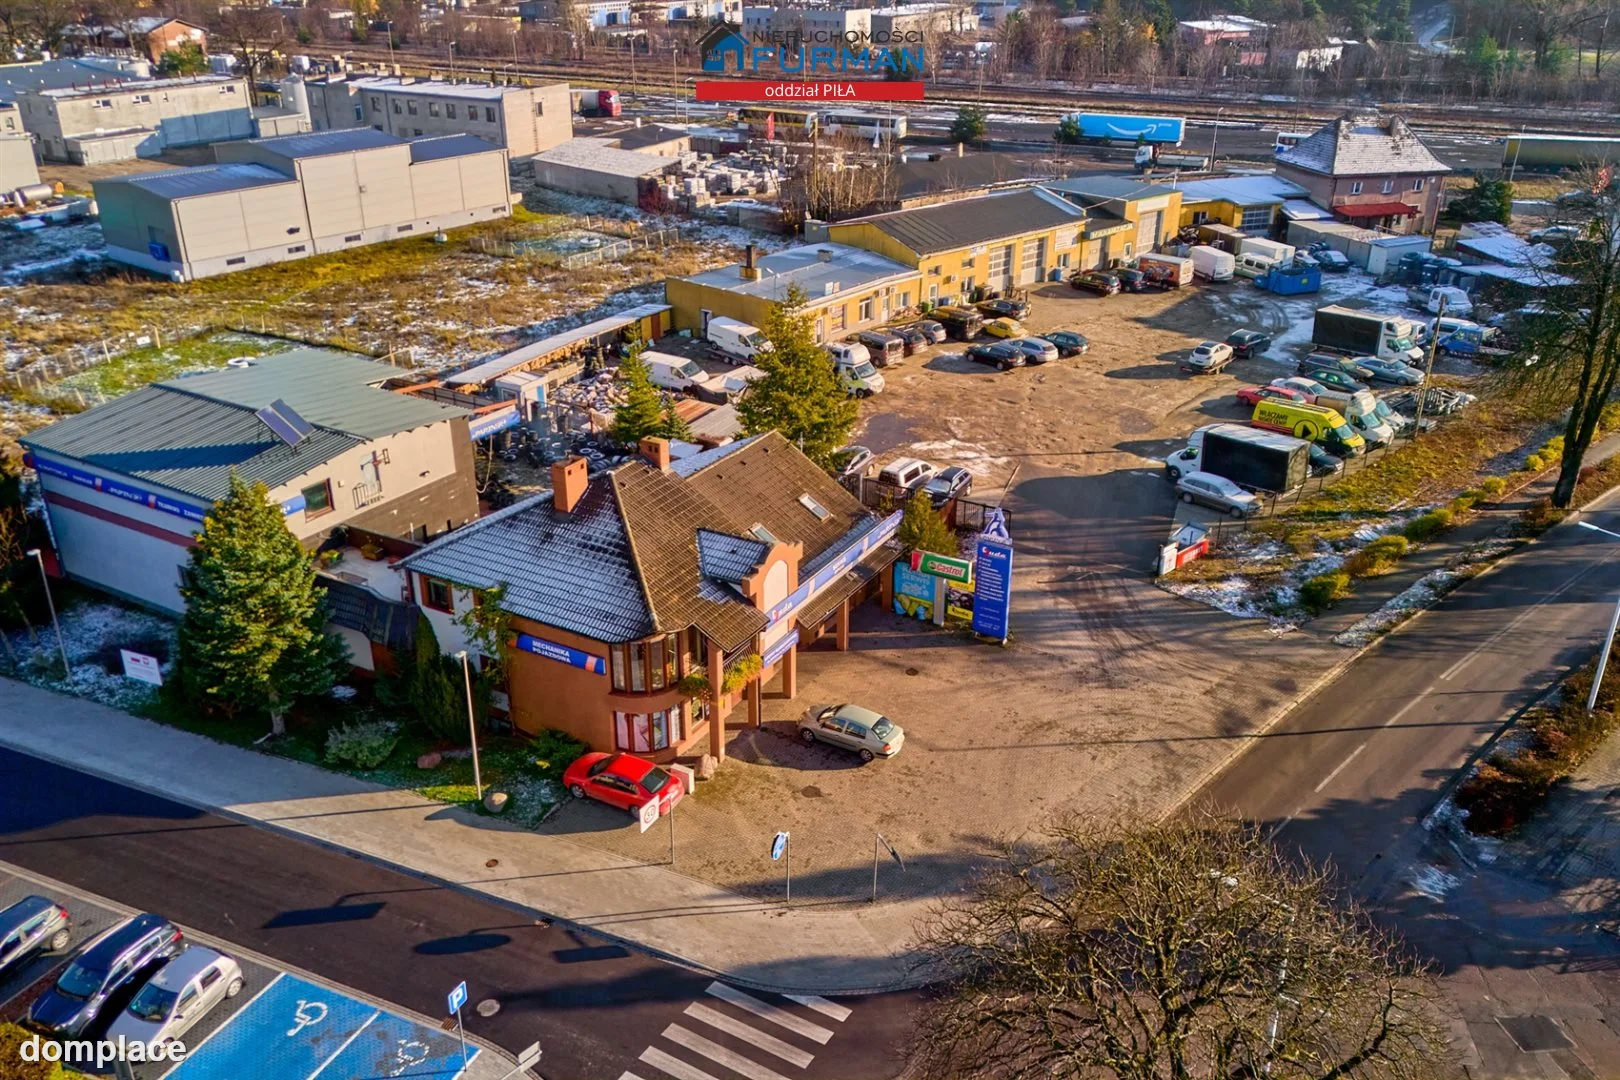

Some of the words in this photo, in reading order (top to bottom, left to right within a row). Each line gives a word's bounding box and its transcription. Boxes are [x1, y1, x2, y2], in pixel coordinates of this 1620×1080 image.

[935, 563, 963, 577] Castrol
[531, 640, 570, 657] MECHANIKA
[532, 646, 572, 663] POJAZDOWA
[452, 987, 463, 1009] P
